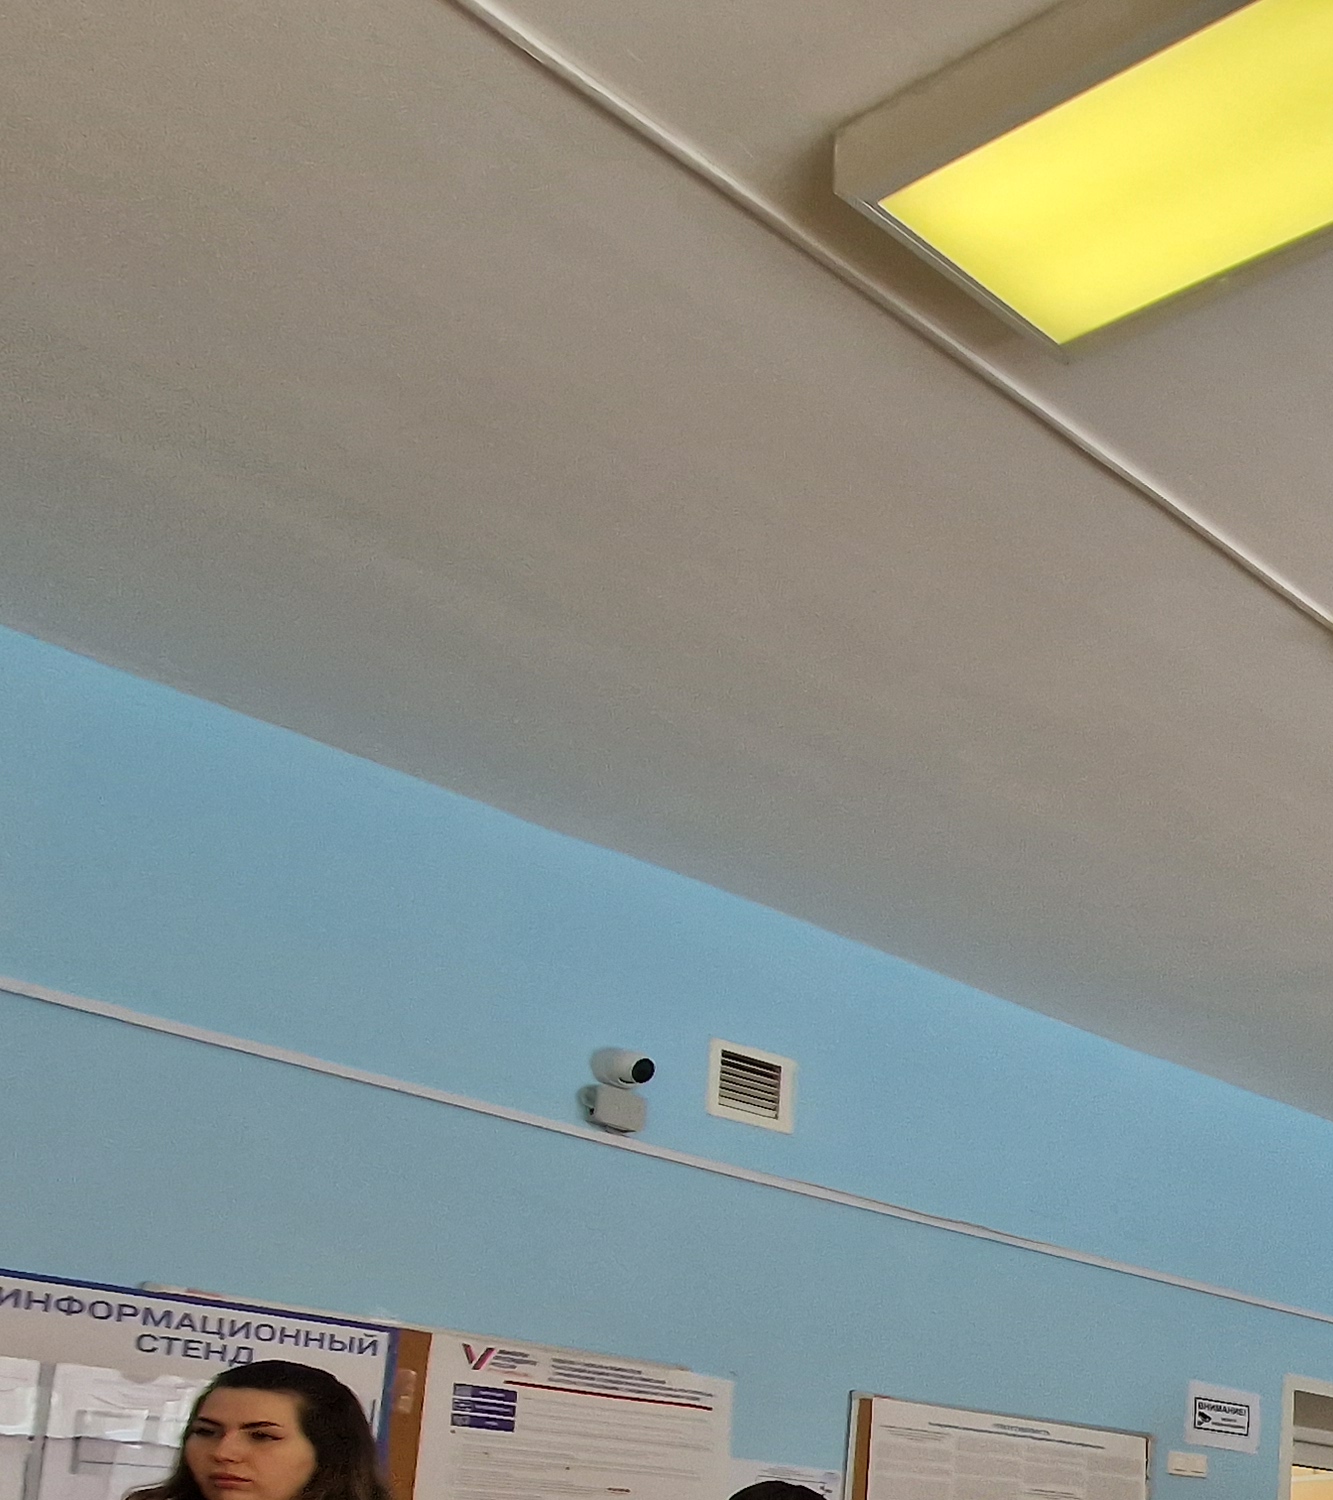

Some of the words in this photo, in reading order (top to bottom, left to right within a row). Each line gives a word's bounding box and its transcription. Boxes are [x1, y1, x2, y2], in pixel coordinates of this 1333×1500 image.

[0, 1286, 380, 1357] ИНФОРМАЦИОННЫЙ
[135, 1332, 255, 1367] СТЕНД
[1197, 1401, 1247, 1417] ВНИМАНИЕ!
